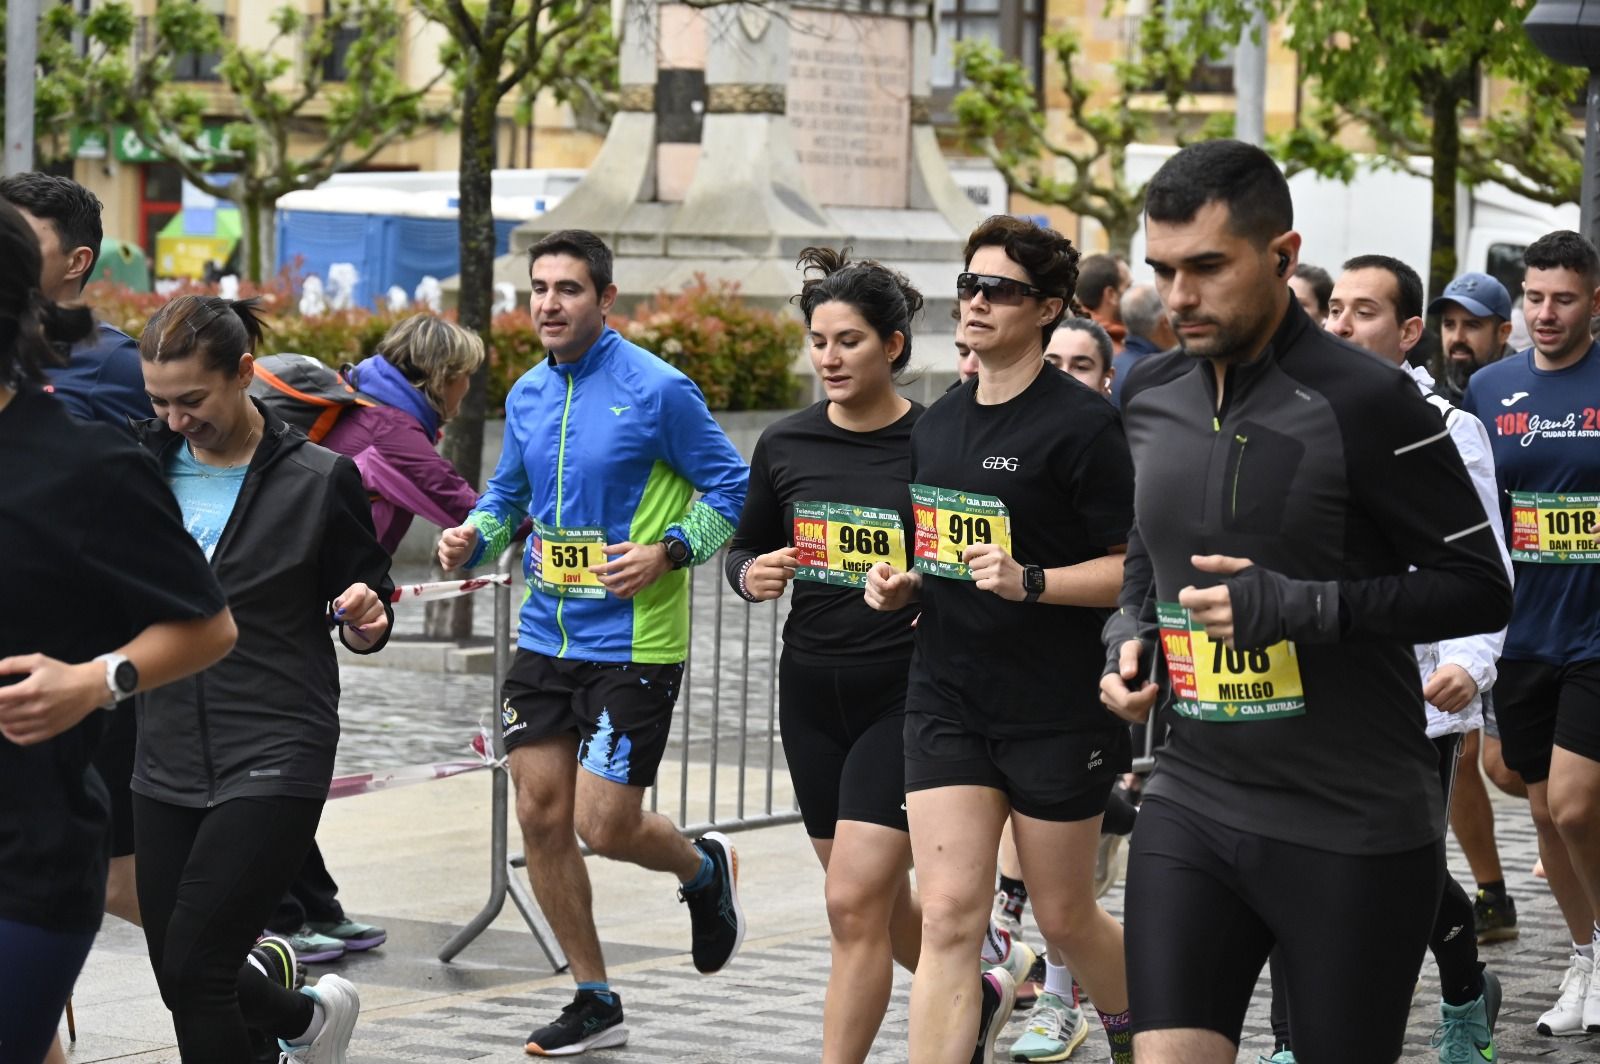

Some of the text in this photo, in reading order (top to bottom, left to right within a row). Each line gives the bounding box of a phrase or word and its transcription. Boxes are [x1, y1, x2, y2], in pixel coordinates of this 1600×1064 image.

[1495, 412, 1529, 436] 10K
[1542, 429, 1600, 438] CIUDAD DE ASTOR
[982, 456, 1019, 472] GDG
[1514, 510, 1536, 524] 10K
[1545, 510, 1596, 535] 1018
[797, 522, 825, 539] 10K
[949, 514, 992, 545] 919
[795, 535, 816, 543] CIUDAD
[796, 541, 826, 551] ASTORGA
[839, 525, 890, 556] 968
[1549, 540, 1572, 550] DANI
[551, 545, 589, 568] 531
[842, 558, 873, 573] Lucía
[562, 573, 581, 583] Javi
[1164, 635, 1191, 656] 10K
[1208, 636, 1270, 674] 708
[1218, 682, 1274, 700] MIELGO
[1240, 705, 1265, 714] CAJA
